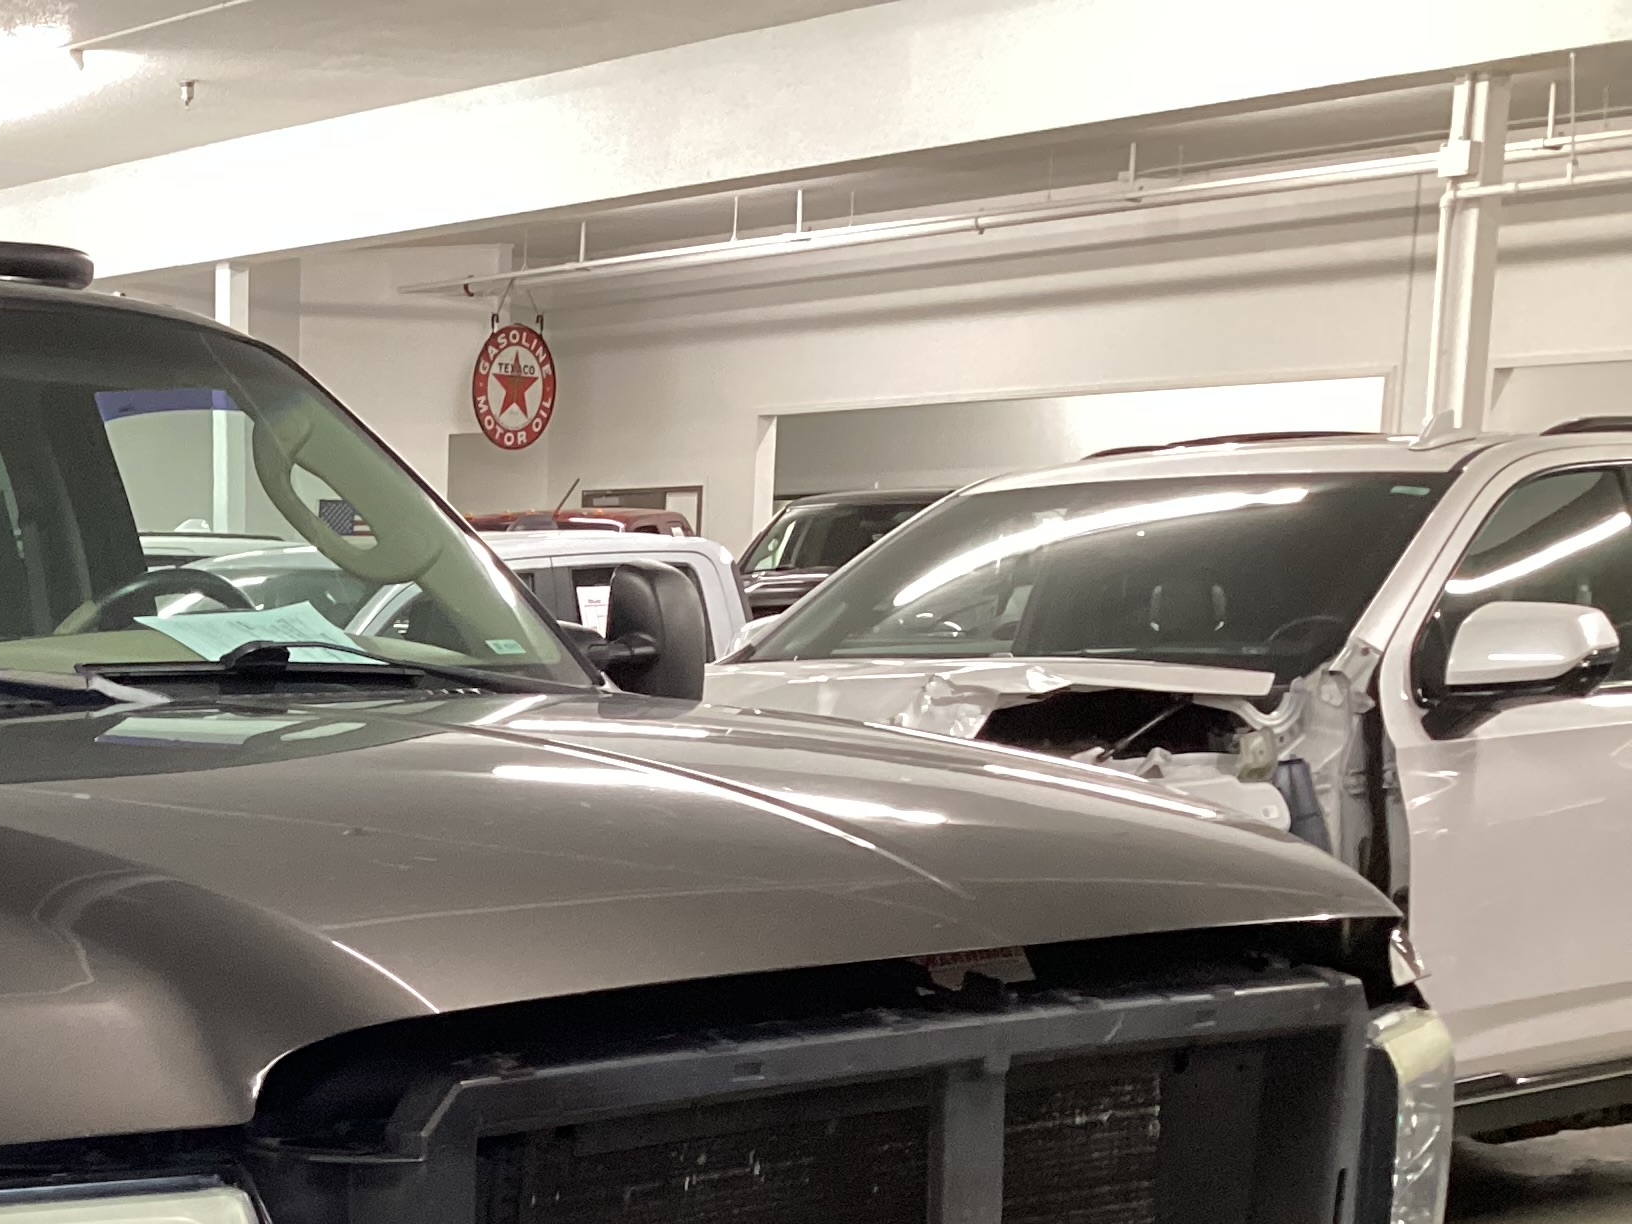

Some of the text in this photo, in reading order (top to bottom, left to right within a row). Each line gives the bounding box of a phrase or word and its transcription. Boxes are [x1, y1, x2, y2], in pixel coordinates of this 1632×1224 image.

[478, 329, 552, 378] GASOLINE
[477, 395, 552, 446] MOTOR OIL
